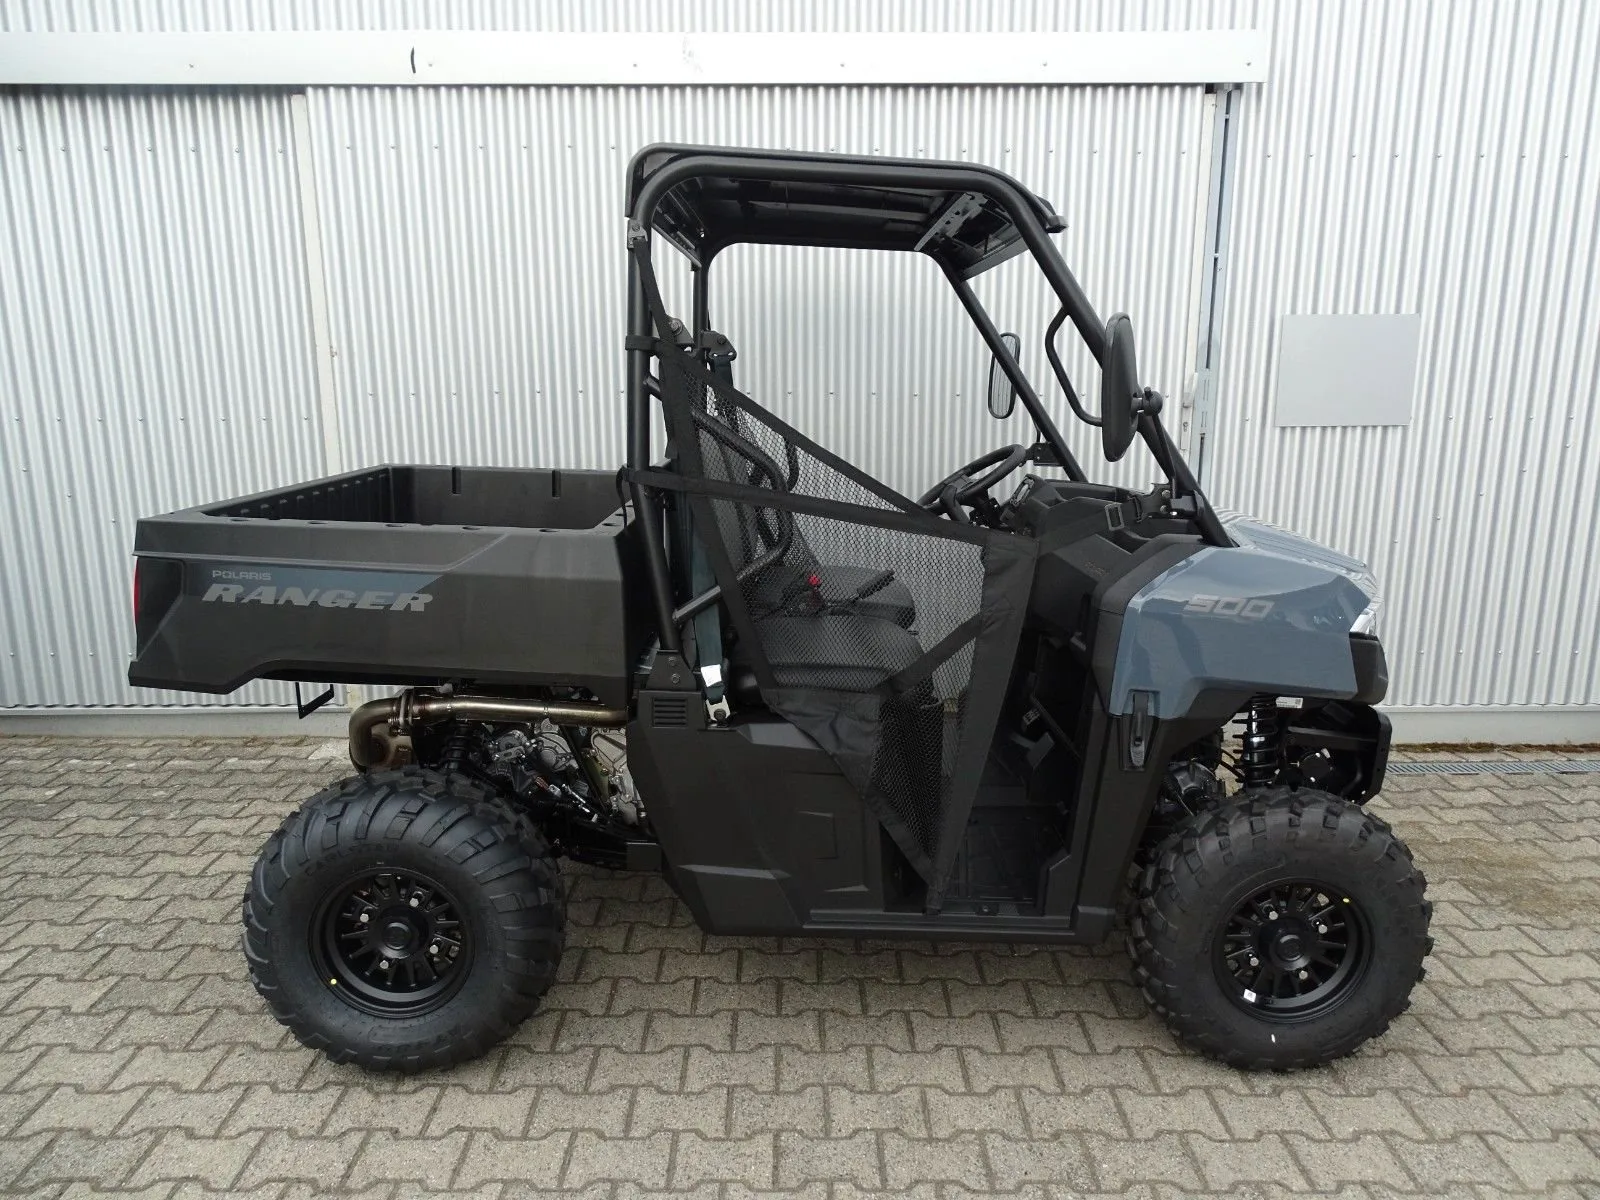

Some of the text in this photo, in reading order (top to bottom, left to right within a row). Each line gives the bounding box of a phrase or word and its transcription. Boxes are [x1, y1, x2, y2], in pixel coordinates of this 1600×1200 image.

[212, 570, 272, 581] POLARIS
[202, 583, 434, 612] RANGER
[1183, 594, 1275, 619] 500
